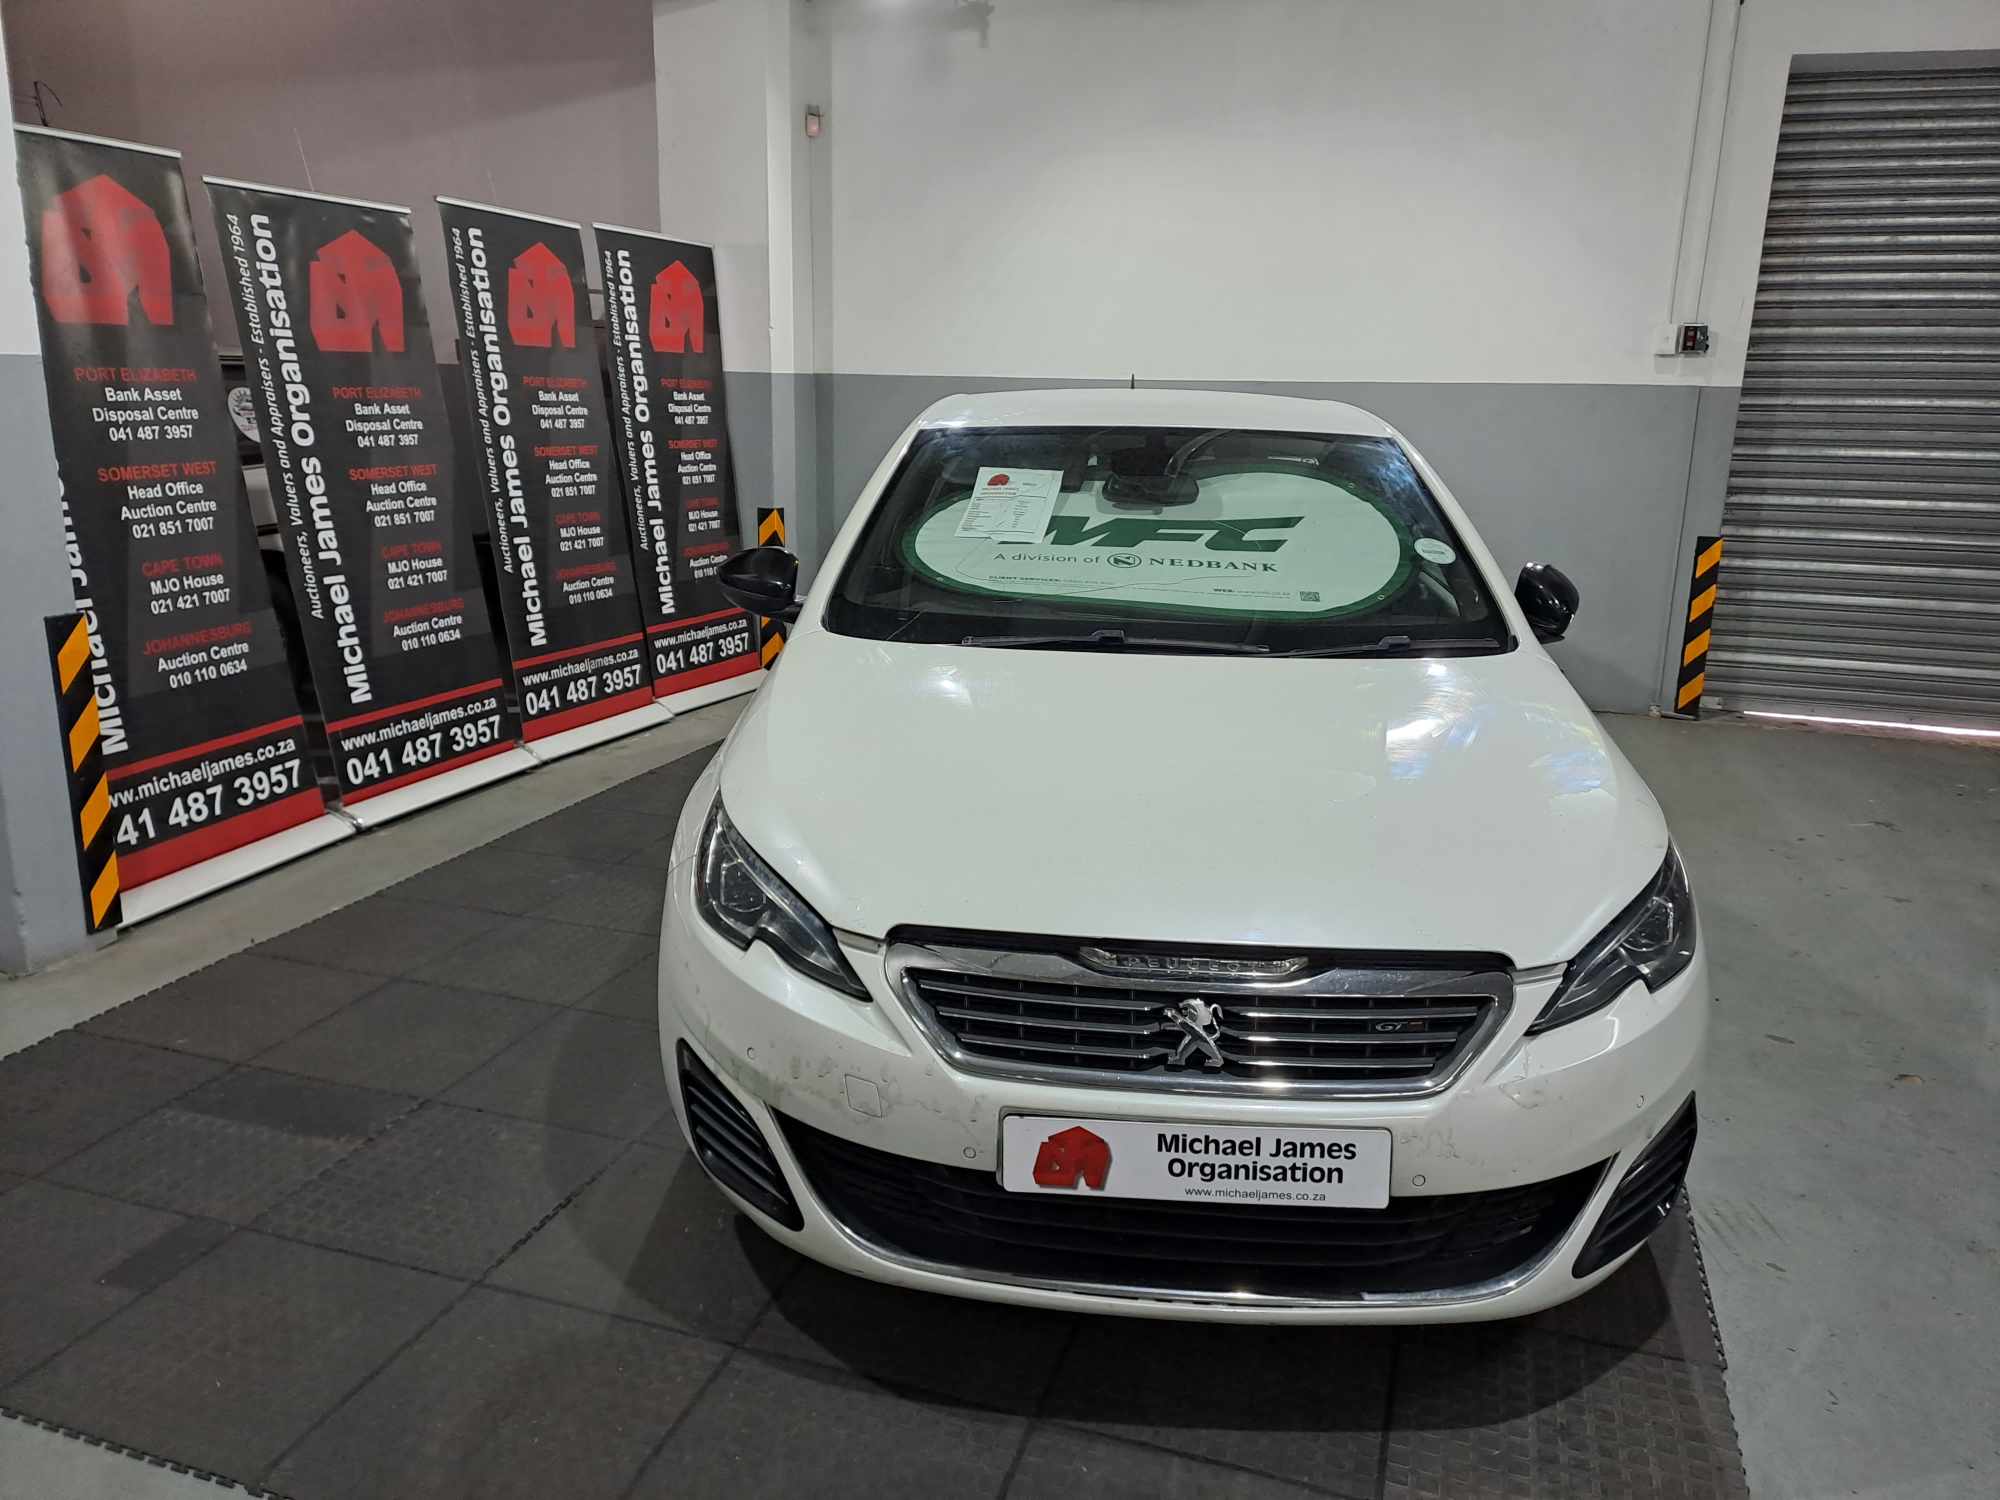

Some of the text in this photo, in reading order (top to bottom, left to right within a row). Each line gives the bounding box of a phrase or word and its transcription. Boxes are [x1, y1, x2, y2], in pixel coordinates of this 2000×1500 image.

[604, 250, 614, 287] 1964
[609, 286, 622, 347] Established
[75, 367, 196, 381] PORT ELIZABETH
[105, 387, 182, 402] Bank Asset
[332, 387, 364, 399] PORT
[538, 391, 579, 403] Bank Asset
[615, 357, 630, 416] Appraisers
[354, 402, 411, 416] Bank Asset
[451, 227, 514, 573] Auctioneers, Valuers and Appraisers Established 1964
[92, 406, 199, 424] Disposal Centre
[226, 213, 324, 619] Auctioneers, Valuers and Appraisers Established 1964
[532, 404, 588, 419] Disposal Centre
[109, 424, 193, 441] 041 487 3957
[346, 418, 424, 434] Disposal Centre
[468, 227, 547, 647] Michael James Organisation
[617, 249, 675, 614] Michael James Organisation
[625, 416, 635, 439] and
[357, 433, 420, 448] 041 487 3957
[250, 214, 373, 704] Michael James Organisation
[549, 459, 590, 471] Head Office
[629, 441, 639, 481] Valuers
[695, 450, 712, 460] Office
[97, 461, 217, 482] SOMERSET WEST
[349, 463, 439, 481] SOMERSET WEST
[545, 472, 598, 484] Auction Centre
[127, 481, 204, 500] Head Office
[371, 480, 428, 495] Head Office
[121, 498, 217, 520] Auction Centre
[366, 495, 437, 513] Auction Centre
[701, 509, 718, 519] House
[133, 517, 214, 539] 021 851 7007
[374, 510, 436, 527] 021 851 7007
[560, 524, 601, 538] MJO House
[560, 541, 573, 552] 021
[142, 554, 224, 577] CAPE TOWN
[387, 557, 443, 574] MJO House
[992, 552, 1280, 573] A division of NEDBANK
[150, 573, 224, 595] MJO House
[387, 570, 448, 590] 021 421 7007
[563, 575, 615, 592] Auction Centre
[151, 588, 230, 615] 021 421 7007
[393, 614, 463, 638] Auction Centre
[653, 618, 748, 649] www.michaeljames.co.za
[143, 621, 253, 656] JOHANNESBURG
[401, 629, 461, 652] 010 110 0634
[157, 641, 249, 672] Auction Centre
[656, 632, 749, 674] 041 487 3957
[168, 660, 248, 689] 010 110 0634
[522, 647, 639, 687] www.michaeljames.co.za
[525, 663, 643, 716] 041 487 3957
[341, 697, 497, 752] www.michaeljames.co.za
[346, 715, 502, 785] 041 487 3957
[116, 759, 301, 845] 41 487 3957
[1157, 1132, 1356, 1161] Michael James
[1167, 1157, 1344, 1184] Organisation
[1185, 1187, 1327, 1201] www.michaeljames.co.za
